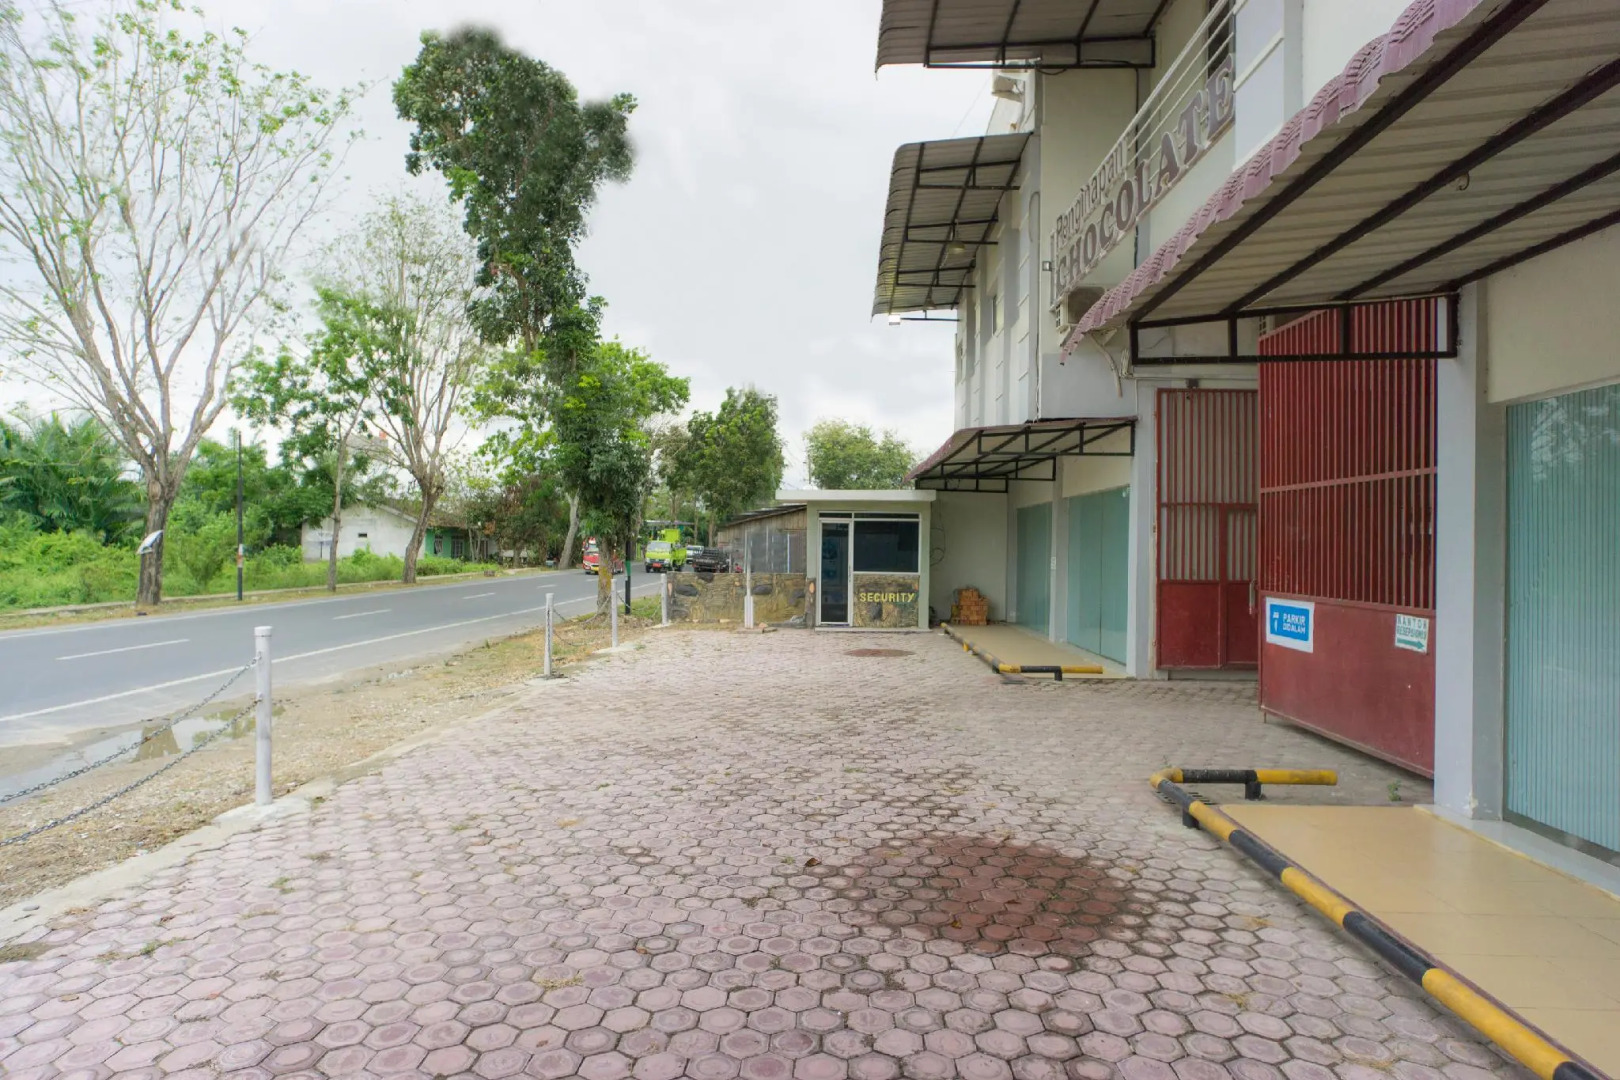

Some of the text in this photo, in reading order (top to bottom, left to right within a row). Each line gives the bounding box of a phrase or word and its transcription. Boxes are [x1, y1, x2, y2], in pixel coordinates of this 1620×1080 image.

[1056, 53, 1234, 291] CHOCOLATE
[860, 593, 914, 603] SECURITY
[1282, 612, 1306, 626] PARKIR
[1397, 615, 1427, 630] KANTOR
[1282, 622, 1306, 634] DIDALAM
